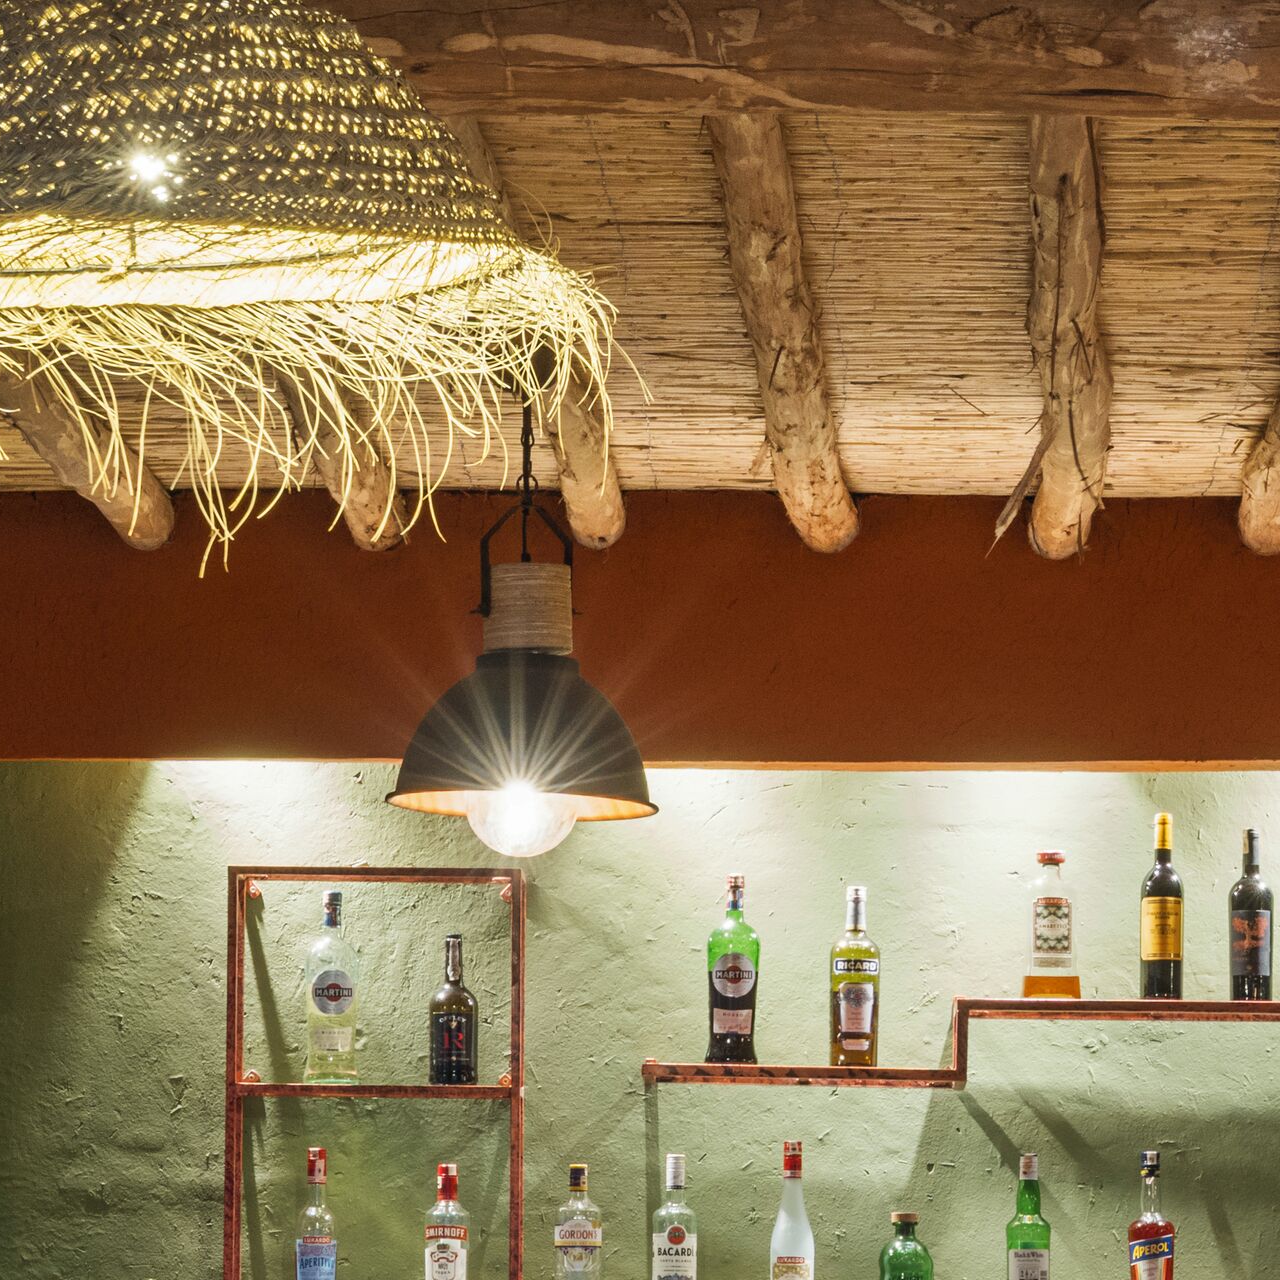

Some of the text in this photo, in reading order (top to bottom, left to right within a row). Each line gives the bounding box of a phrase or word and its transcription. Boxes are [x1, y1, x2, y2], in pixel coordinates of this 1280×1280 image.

[837, 961, 877, 971] RICARD
[716, 971, 752, 979] MARTINI
[316, 988, 352, 996] MARTINI
[426, 1228, 465, 1238] SMIRNOFF
[1133, 1242, 1169, 1260] APEROL
